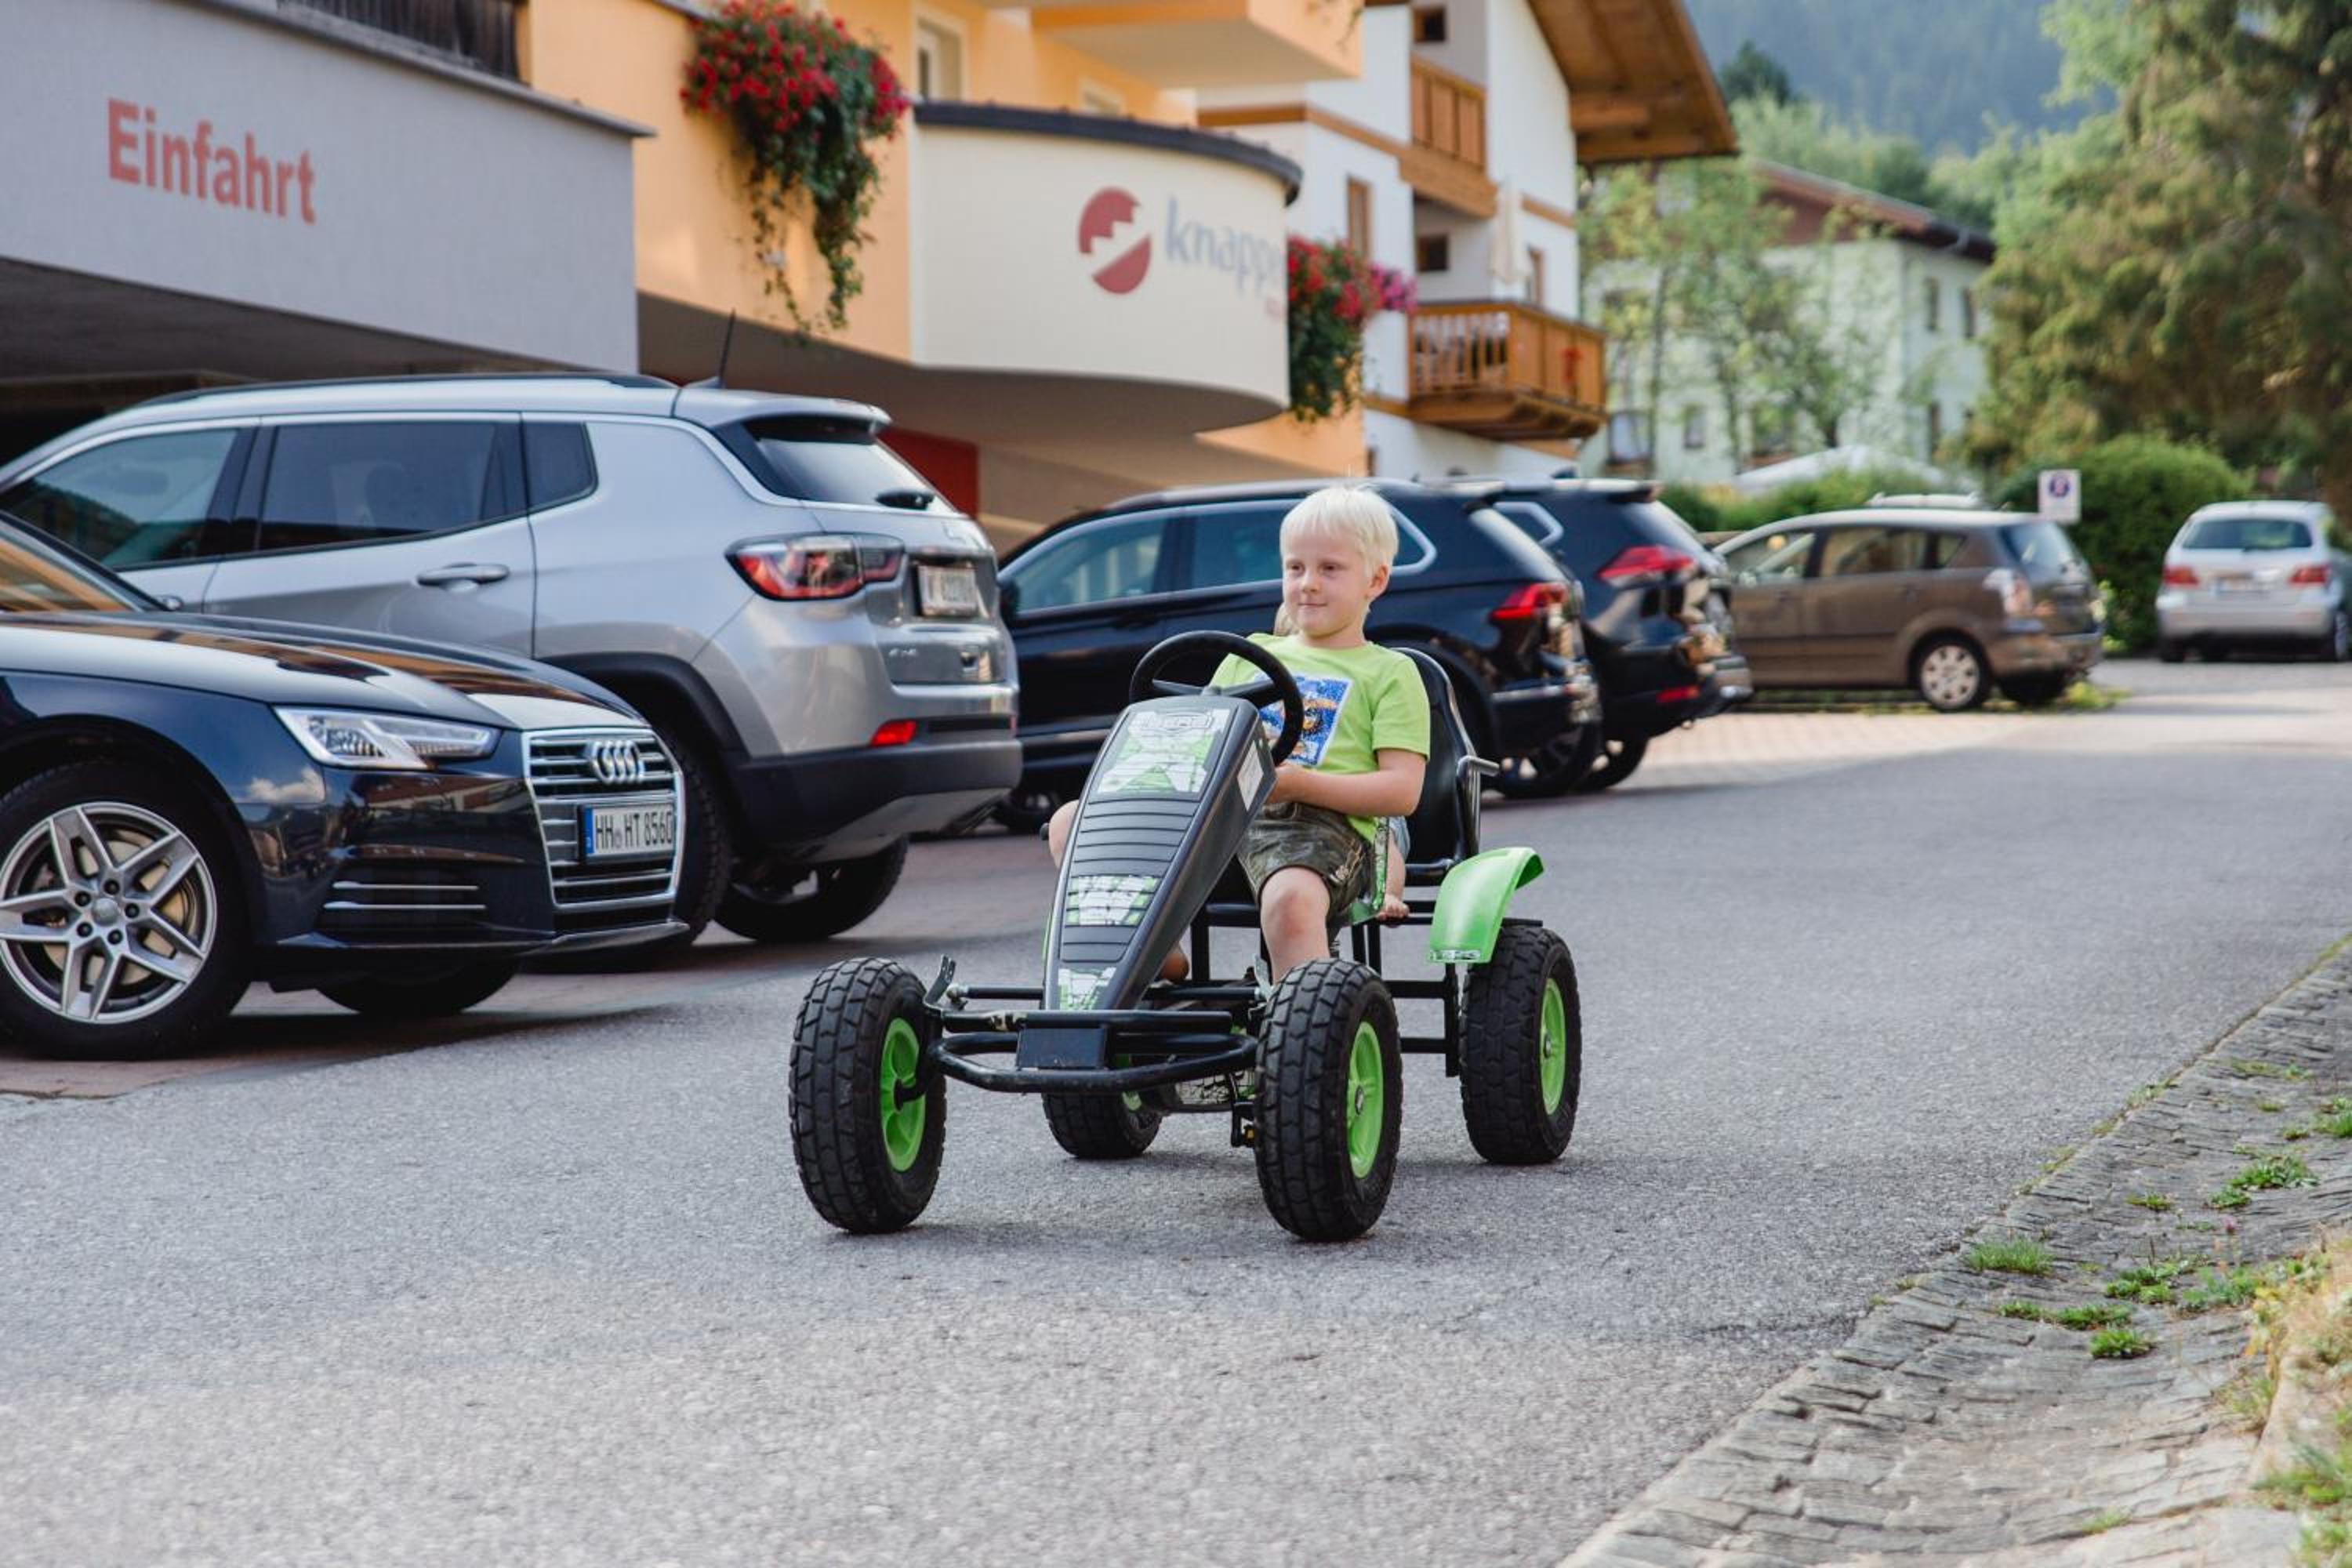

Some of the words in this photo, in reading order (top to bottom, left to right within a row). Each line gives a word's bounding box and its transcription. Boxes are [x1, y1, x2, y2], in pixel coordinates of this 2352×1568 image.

[108, 97, 316, 225] Einfahrt
[595, 814, 614, 850] HH
[624, 812, 641, 847] HT
[644, 811, 673, 846] 8560
